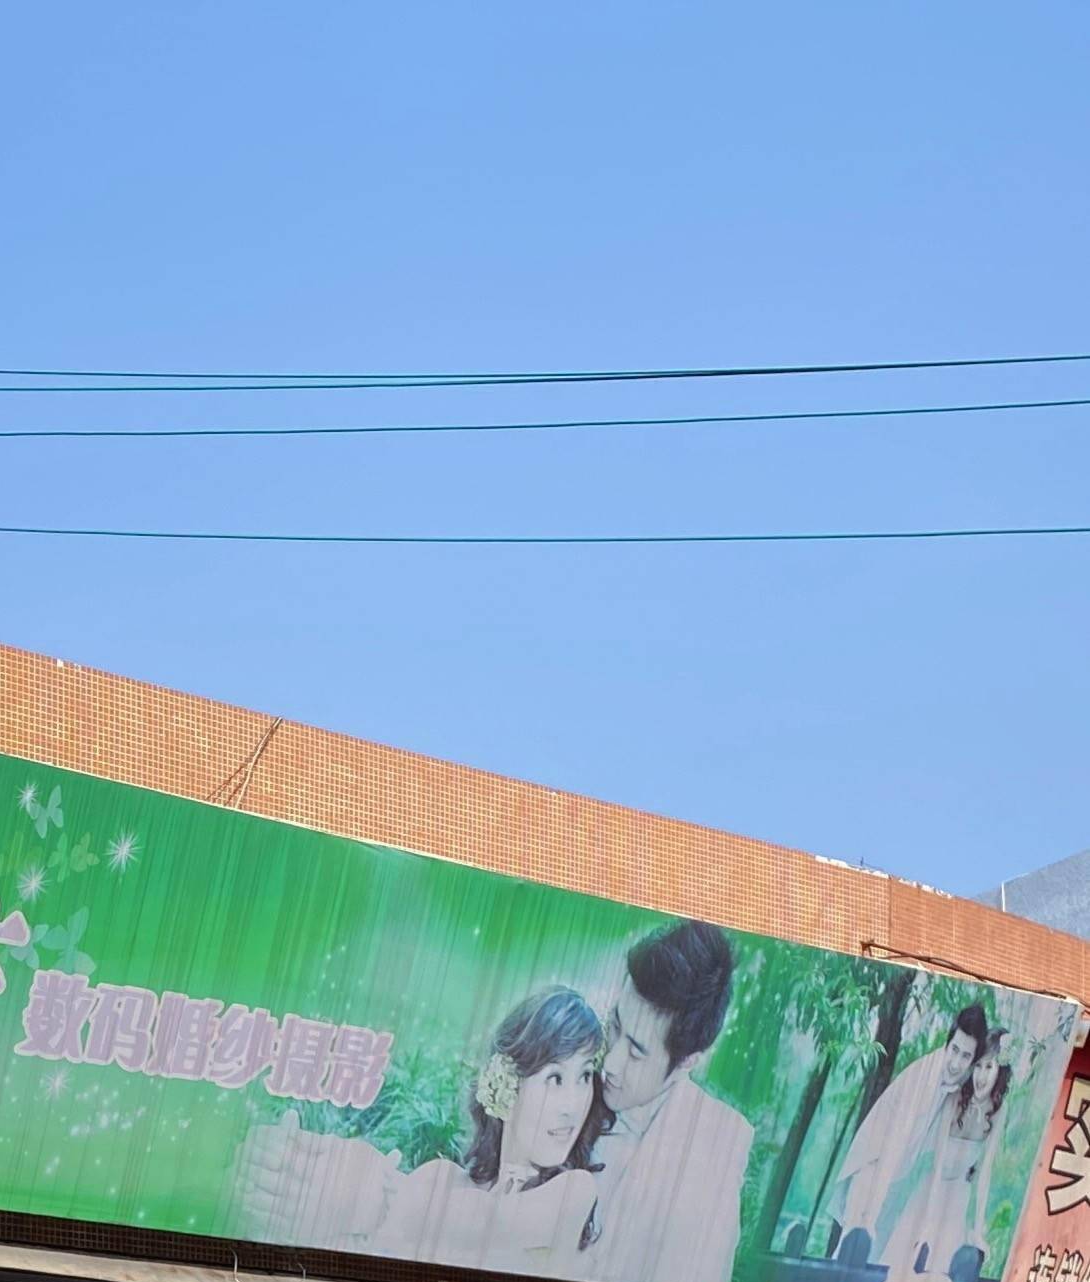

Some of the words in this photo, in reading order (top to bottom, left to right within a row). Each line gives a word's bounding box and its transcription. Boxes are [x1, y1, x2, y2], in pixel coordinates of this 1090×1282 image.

[14, 969, 394, 1109] 数码婚纱摄影
